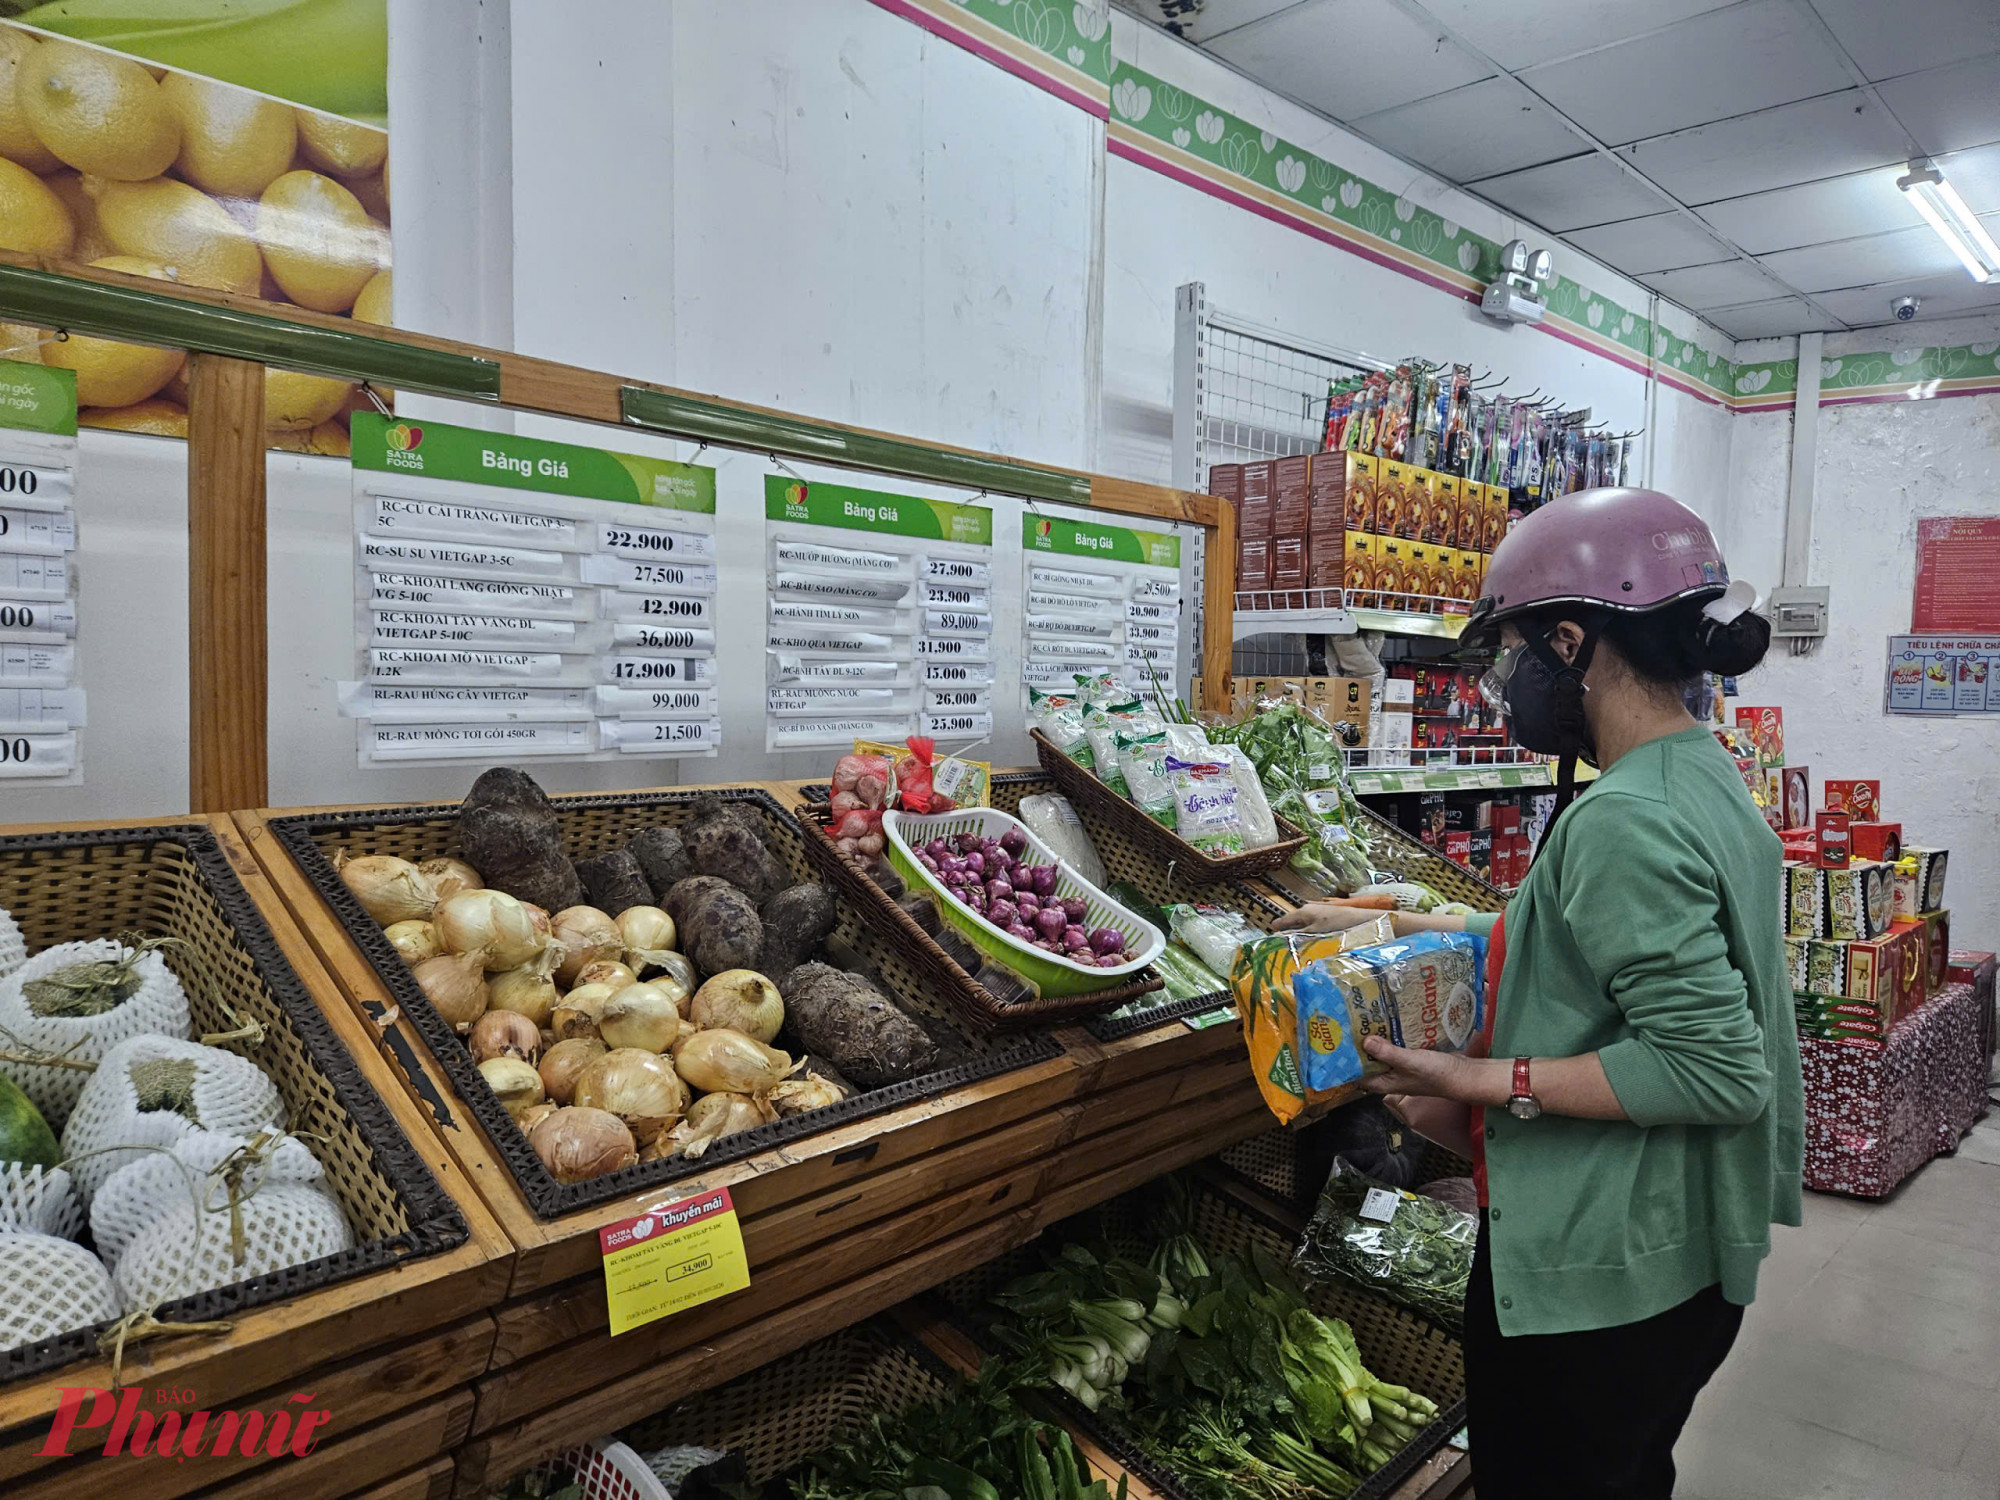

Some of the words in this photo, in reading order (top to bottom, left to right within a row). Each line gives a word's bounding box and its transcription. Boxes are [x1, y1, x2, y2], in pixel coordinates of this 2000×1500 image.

[386, 450, 423, 462] SATRA
[482, 449, 532, 477] Bảng
[538, 458, 568, 478] Giá
[386, 458, 424, 470] FOODS
[844, 501, 876, 522] Bảng
[878, 506, 898, 522] Giá
[378, 516, 396, 527] 5C
[500, 513, 554, 528] VIETGAP
[606, 530, 674, 551] 22.900
[1075, 533, 1098, 550] Bảng
[1099, 536, 1113, 550] Giá
[1652, 527, 1708, 550] Chubb
[365, 544, 407, 558] RC-SU
[409, 548, 426, 558] SU
[429, 550, 487, 565] VIETGAP
[489, 555, 515, 566] 3-5C
[634, 566, 684, 584] 27,500
[930, 561, 973, 578] 27.900
[379, 573, 447, 589] RC-KHOAI
[450, 580, 484, 594] LANG
[376, 588, 396, 600] VG
[398, 589, 433, 603] 5-10C
[928, 588, 970, 604] 23.900
[638, 599, 702, 616] 42.900
[1129, 605, 1160, 618] 20.900
[379, 612, 449, 625] RC-KHOAI
[941, 613, 978, 630] 89,000
[376, 627, 438, 640] VIETGAP
[440, 630, 473, 641] 5-10C
[636, 630, 694, 648] 36,000
[1129, 627, 1160, 638] 33.900
[808, 640, 826, 649] QUA
[828, 640, 862, 650] VIETGAP
[918, 641, 962, 654] 31.900
[379, 651, 447, 663] RC-KHOAI
[475, 654, 528, 666] VIETGAP
[610, 662, 676, 678] 47.900
[374, 690, 419, 700] RL-RAU
[482, 691, 529, 701] VIETGAP
[771, 689, 803, 698] RL-RAU
[935, 692, 977, 706] 26.000
[652, 693, 700, 710] 99,000
[768, 701, 806, 710] VIETGAP
[931, 717, 973, 730] 25.900
[377, 730, 422, 741] RL-RAU
[506, 729, 537, 738] 450GR
[654, 725, 702, 742] 21,500
[1837, 1004, 1874, 1016] Colgate
[1310, 1021, 1322, 1040] Sa
[1316, 1014, 1336, 1051] Giang
[1839, 1020, 1876, 1032] Colgate
[1844, 1036, 1881, 1049] Colgate
[661, 1202, 702, 1228] khuyến
[703, 1195, 723, 1213] mãi
[606, 1228, 631, 1240] SATRA
